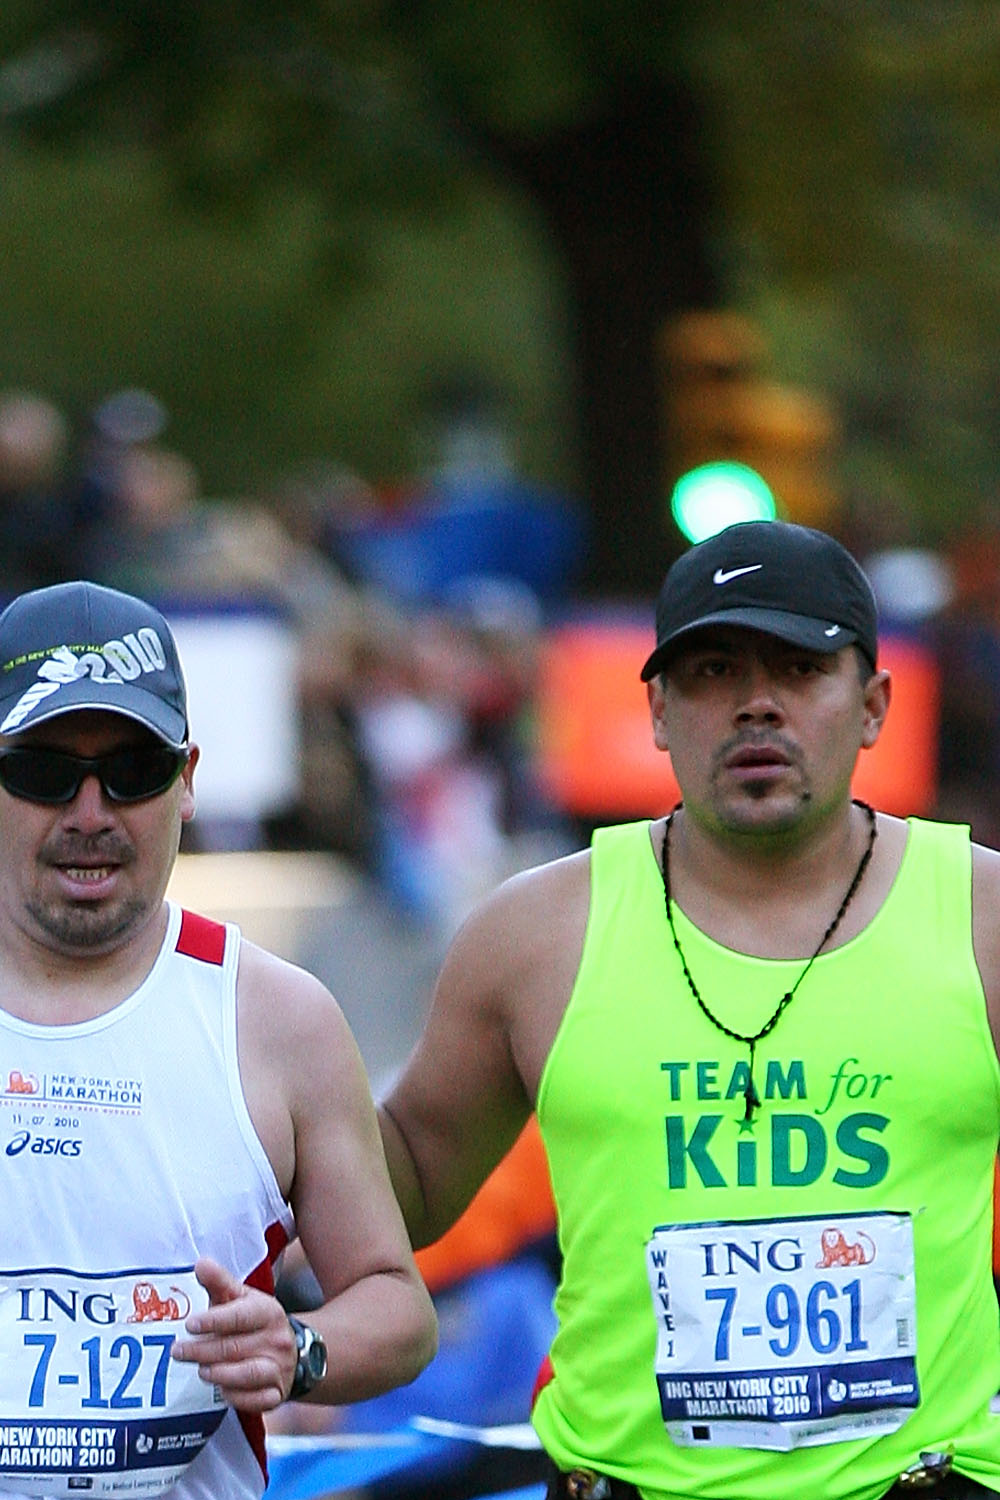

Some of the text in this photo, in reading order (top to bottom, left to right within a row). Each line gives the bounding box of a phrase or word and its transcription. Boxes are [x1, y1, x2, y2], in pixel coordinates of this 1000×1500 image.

[74, 628, 166, 684] 2010
[51, 1085, 142, 1104] MARATHON
[52, 1075, 76, 1085] NEW
[82, 1077, 111, 1088] YORK
[116, 1079, 144, 1090] CITY
[660, 1058, 892, 1115] TEAM for
[31, 1137, 83, 1157] asics
[700, 1238, 805, 1278] ING
[16, 1287, 119, 1325] ING
[652, 1250, 676, 1332] WAVE
[704, 1278, 869, 1362] 7-961
[23, 1334, 176, 1409] 7-127
[665, 1375, 810, 1399] ING NEW YORK CITY
[686, 1395, 811, 1417] MARATHON 2010
[35, 1427, 78, 1447] YORK
[80, 1428, 117, 1447] CITY
[78, 1448, 116, 1467] 2010
